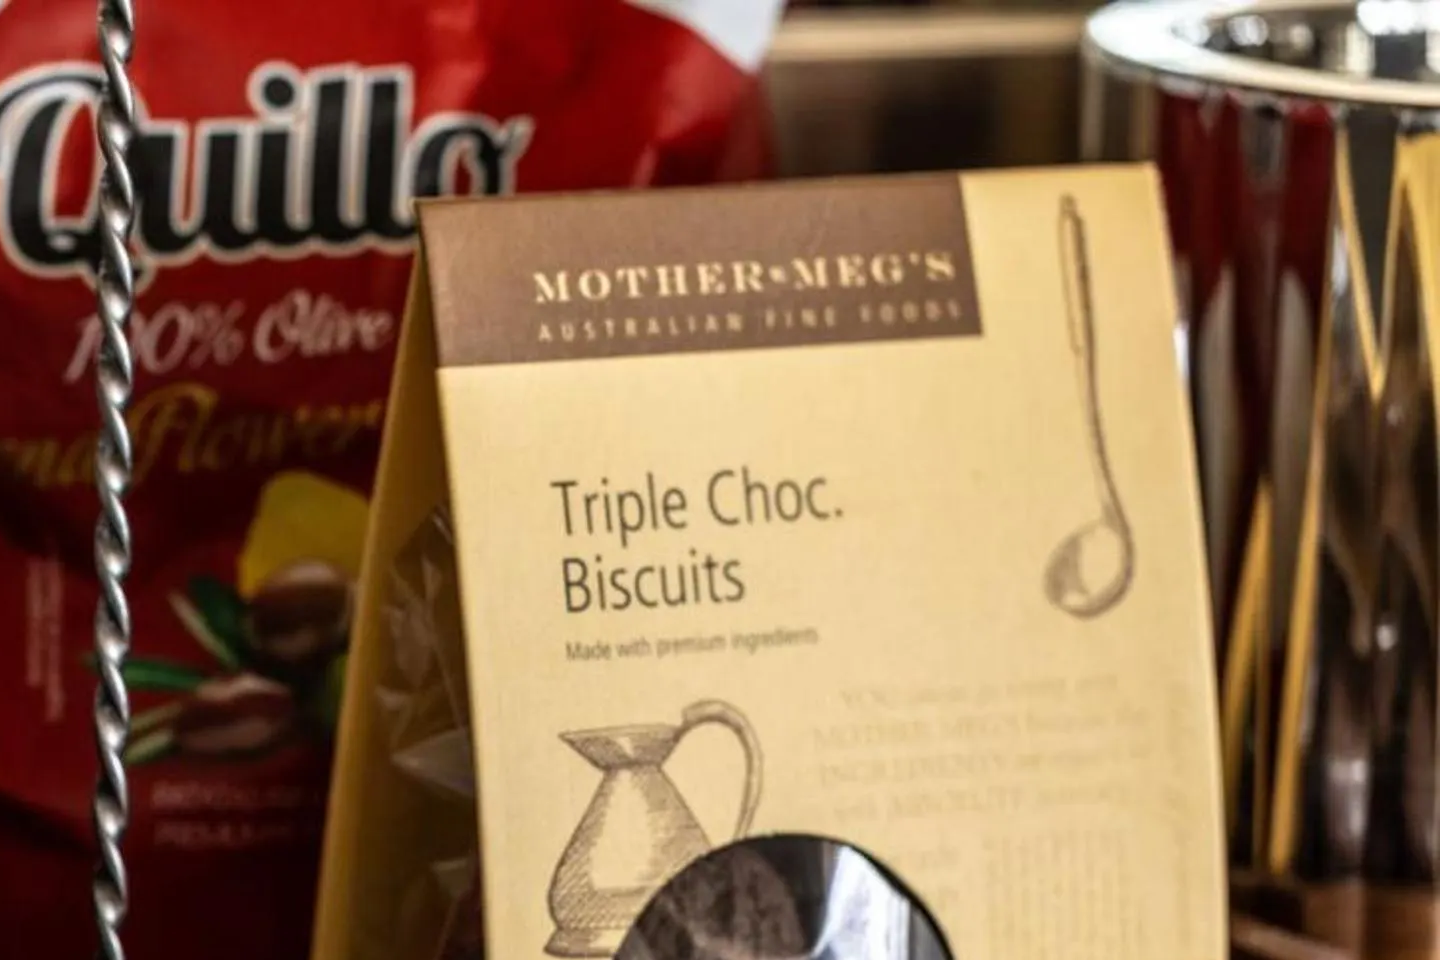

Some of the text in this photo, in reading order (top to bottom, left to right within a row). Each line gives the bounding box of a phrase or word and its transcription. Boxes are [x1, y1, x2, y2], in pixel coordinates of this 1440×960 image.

[532, 252, 956, 304] MOTHER MEG'S
[537, 311, 744, 343] AUSTRALIAN
[550, 465, 844, 548] Triple Choc.
[562, 548, 746, 613] Biscuits
